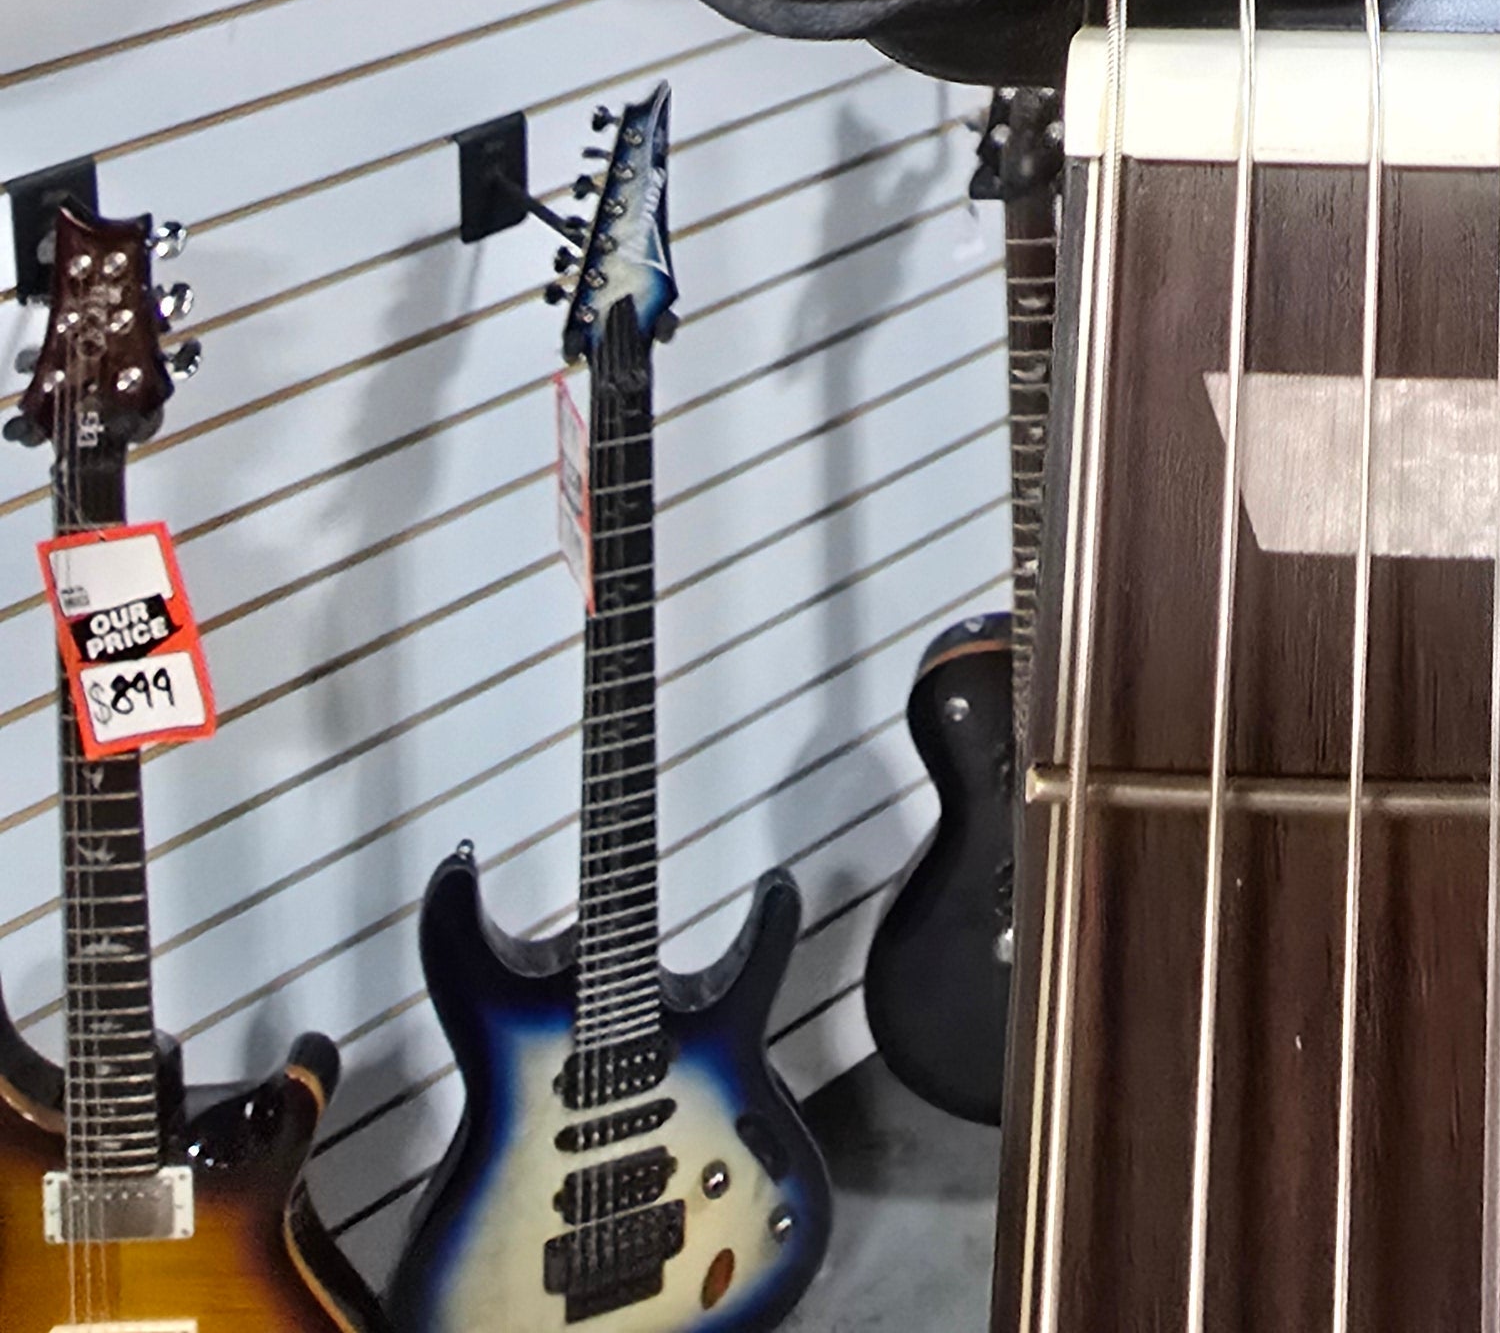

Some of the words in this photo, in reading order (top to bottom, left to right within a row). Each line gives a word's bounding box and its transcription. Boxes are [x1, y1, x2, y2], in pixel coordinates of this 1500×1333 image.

[86, 616, 170, 660] PRICE
[90, 601, 149, 636] OUR
[88, 667, 176, 725] $899
